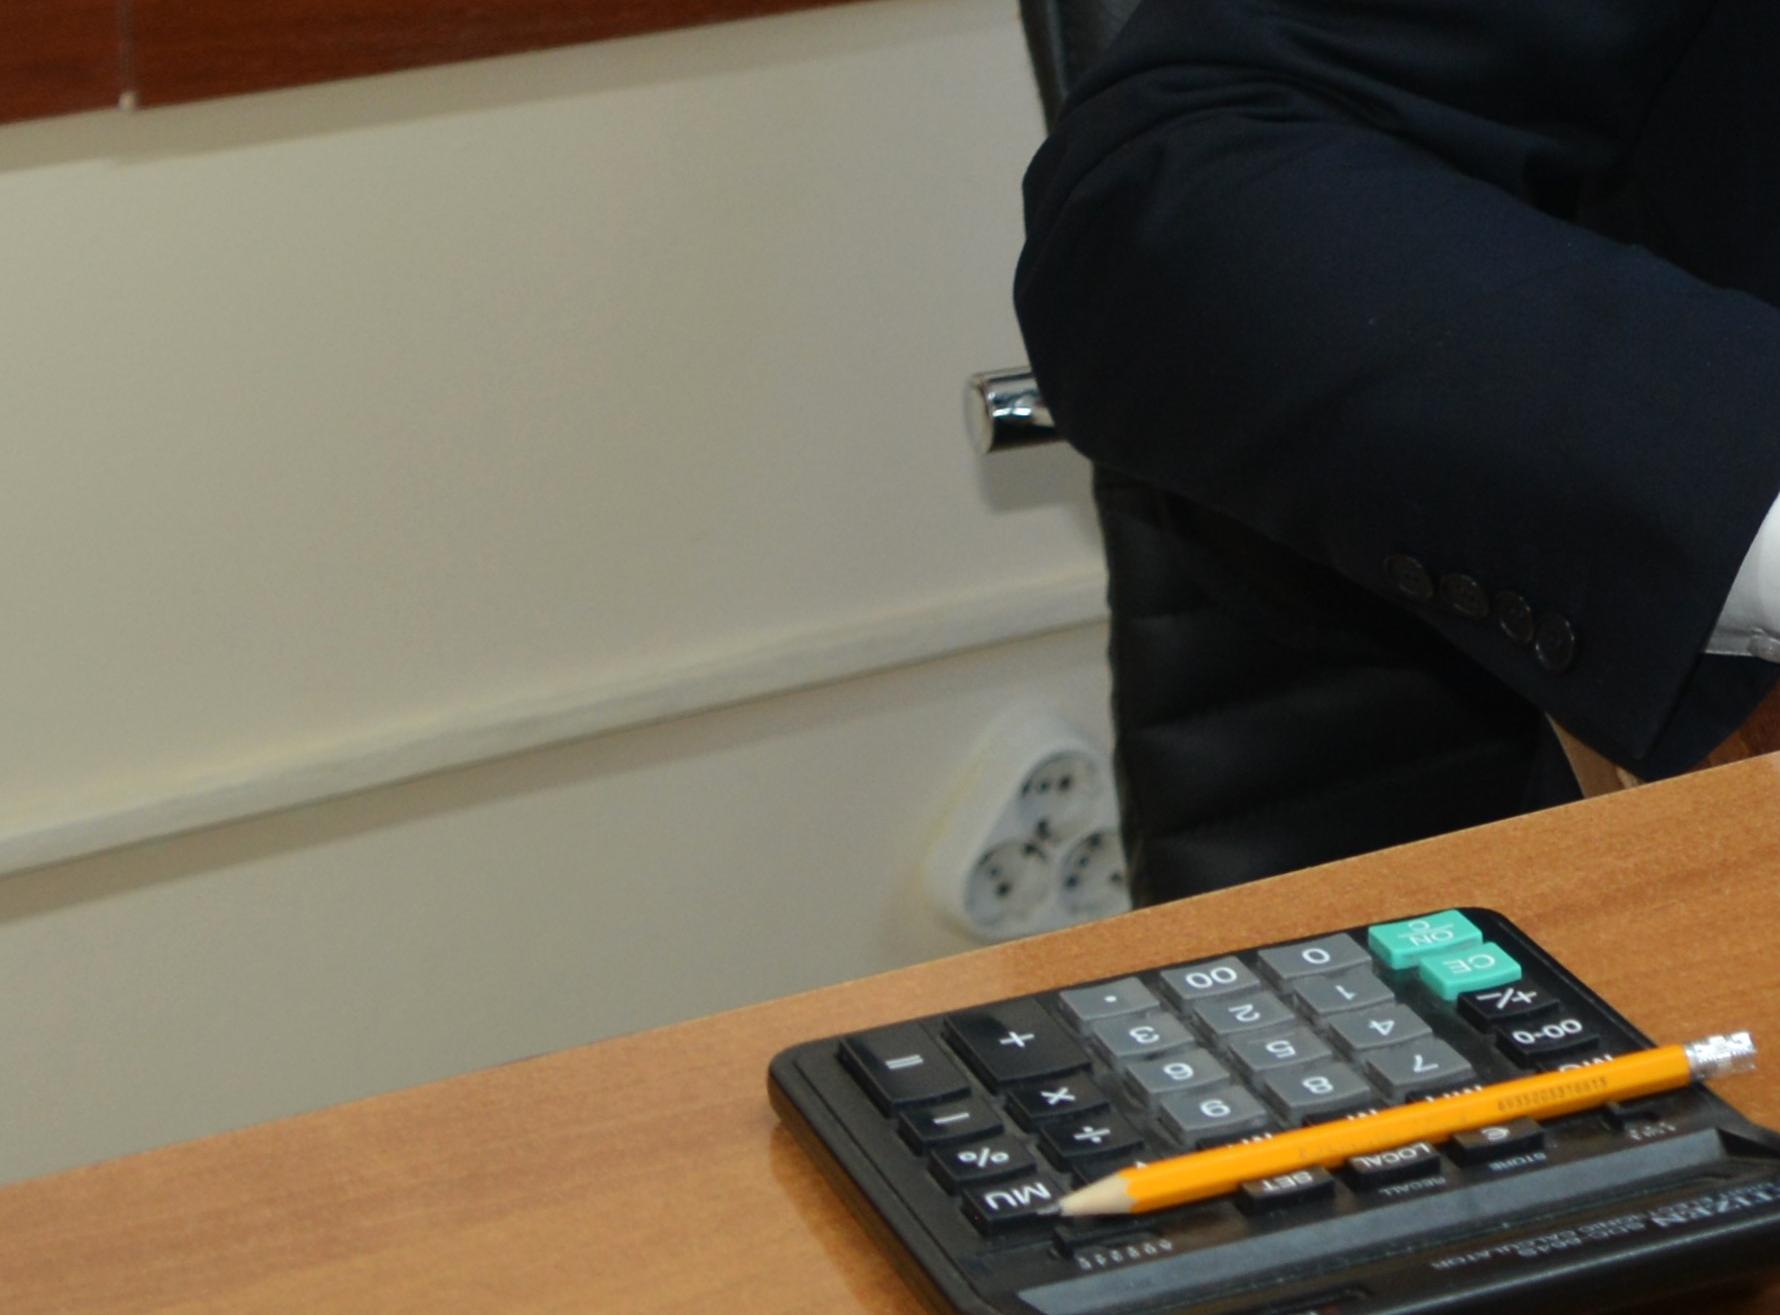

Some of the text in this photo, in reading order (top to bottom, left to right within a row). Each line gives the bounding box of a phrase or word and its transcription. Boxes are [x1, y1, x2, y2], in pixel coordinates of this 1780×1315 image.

[1408, 930, 1452, 945] ON
[1185, 947, 1329, 988] 0 00
[1453, 954, 1496, 973] CE
[1128, 985, 1354, 1043] 1 2 3
[1162, 1019, 1393, 1079] 4 5 6
[1199, 1054, 1437, 1116] 7 8 9
[1352, 1142, 1429, 1166] LOCAL
[1488, 1152, 1546, 1170] STORE
[1262, 1171, 1312, 1191] SET
[1379, 1176, 1446, 1195] RECALL
[984, 1182, 1050, 1208] MU
